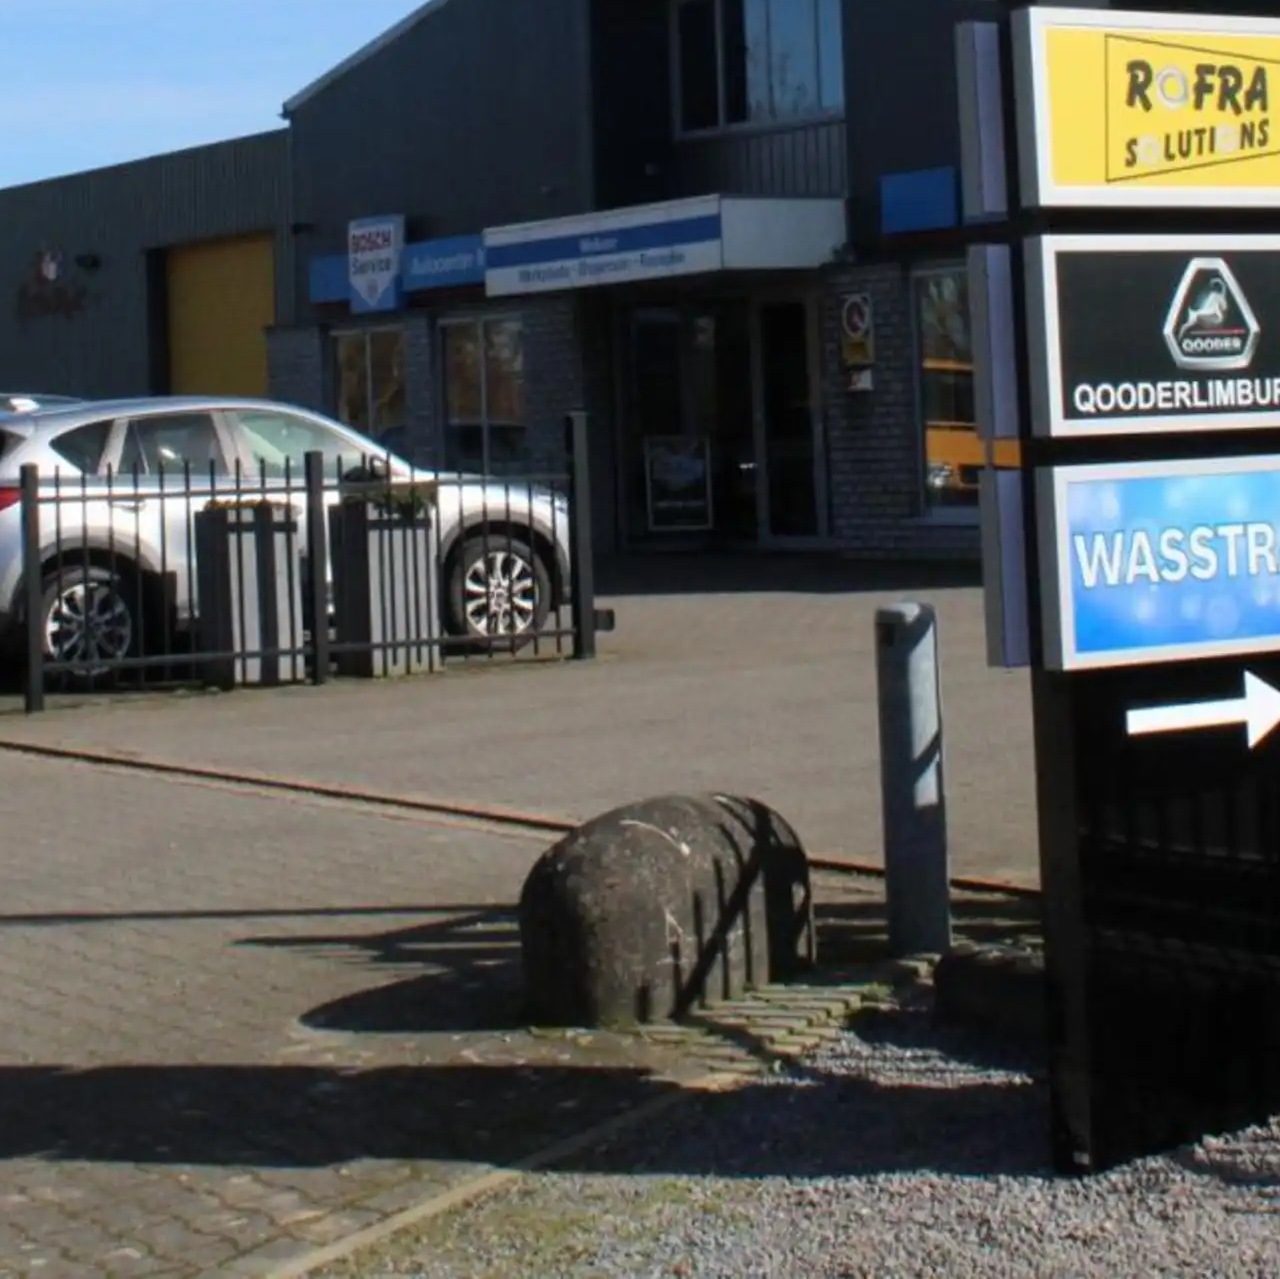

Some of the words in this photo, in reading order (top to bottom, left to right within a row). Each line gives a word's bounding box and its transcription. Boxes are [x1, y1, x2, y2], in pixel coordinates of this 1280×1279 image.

[1125, 59, 1270, 117] ROFRA
[1124, 119, 1270, 169] SOLUTIONS
[1182, 337, 1242, 354] QOODER
